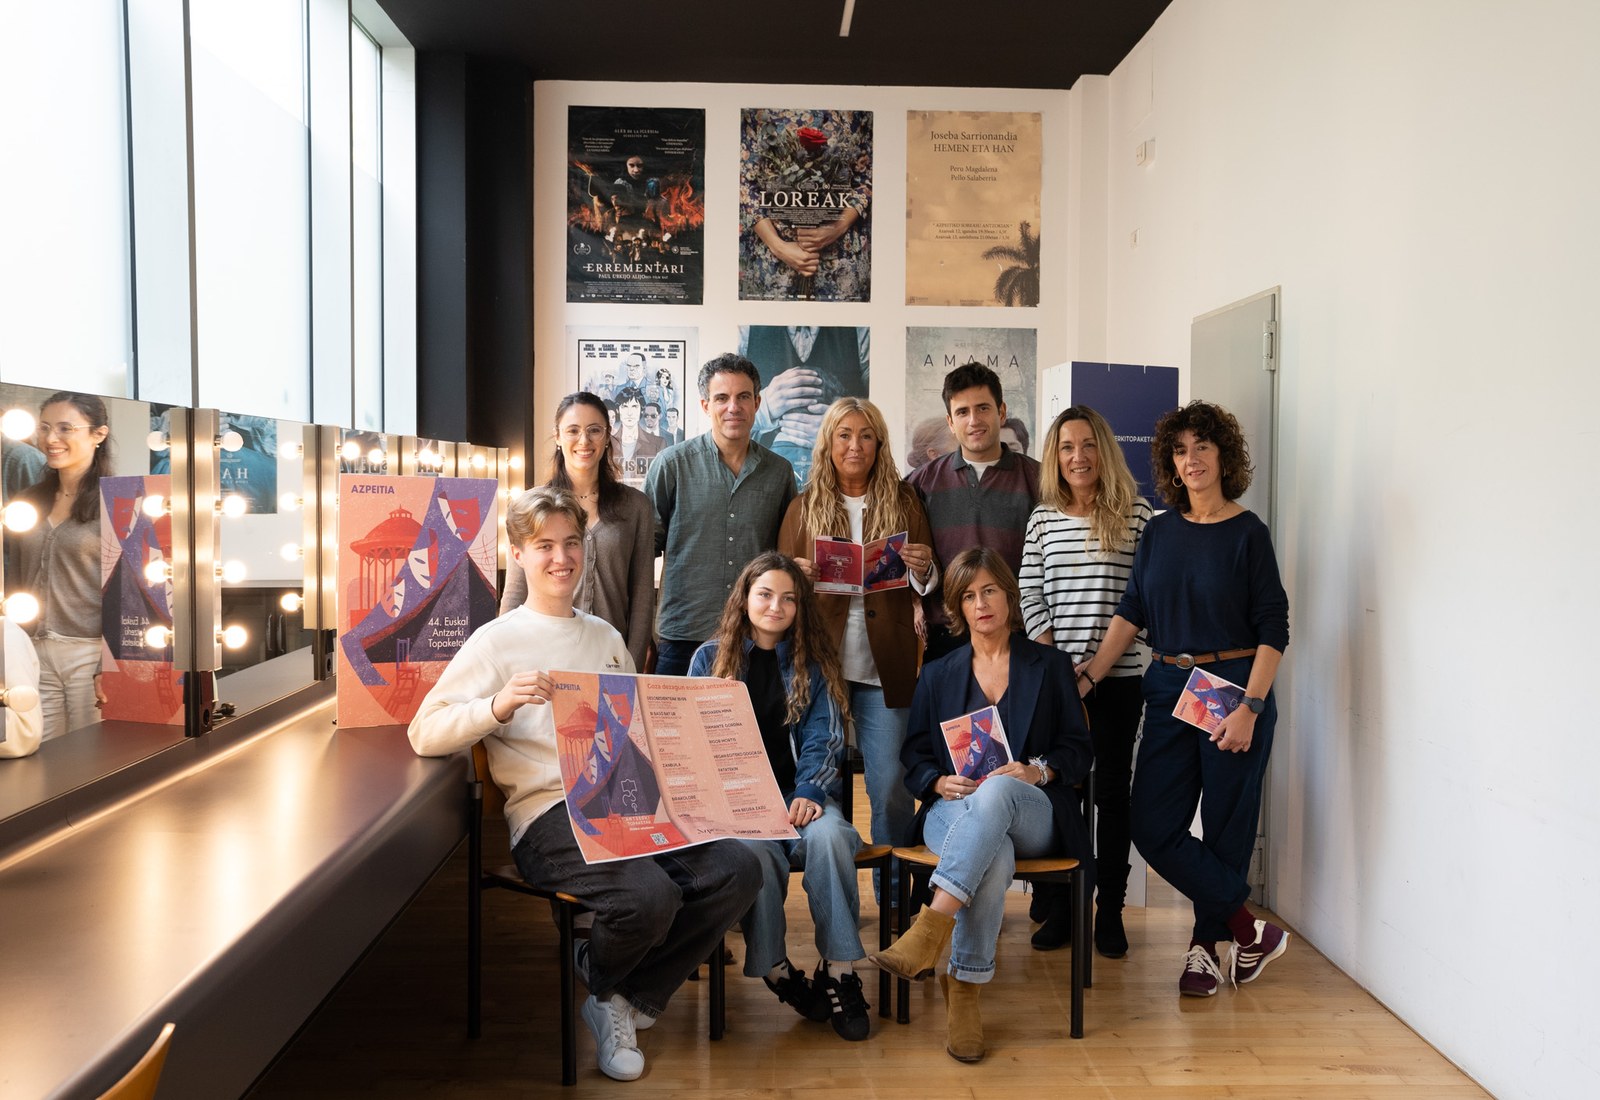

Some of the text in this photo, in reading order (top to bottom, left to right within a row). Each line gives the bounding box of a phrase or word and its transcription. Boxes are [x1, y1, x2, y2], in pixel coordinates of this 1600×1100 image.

[930, 131, 1018, 141] Joseba Sarrionandia
[933, 144, 1014, 153] HEMEN ETA HAN
[965, 165, 998, 174] Magdalena
[966, 174, 997, 182] Salaberria
[759, 191, 854, 208] LOREAK
[583, 262, 684, 274] ERREMENTARI
[923, 354, 1019, 367] AMAMA
[1113, 435, 1157, 443] ERKITOPAKETA
[625, 460, 635, 472] IS
[350, 484, 395, 495] AZPEITIA
[428, 616, 469, 627] 44. Euskal
[432, 627, 464, 638] Antzerki
[555, 683, 582, 691] AZPEITIA
